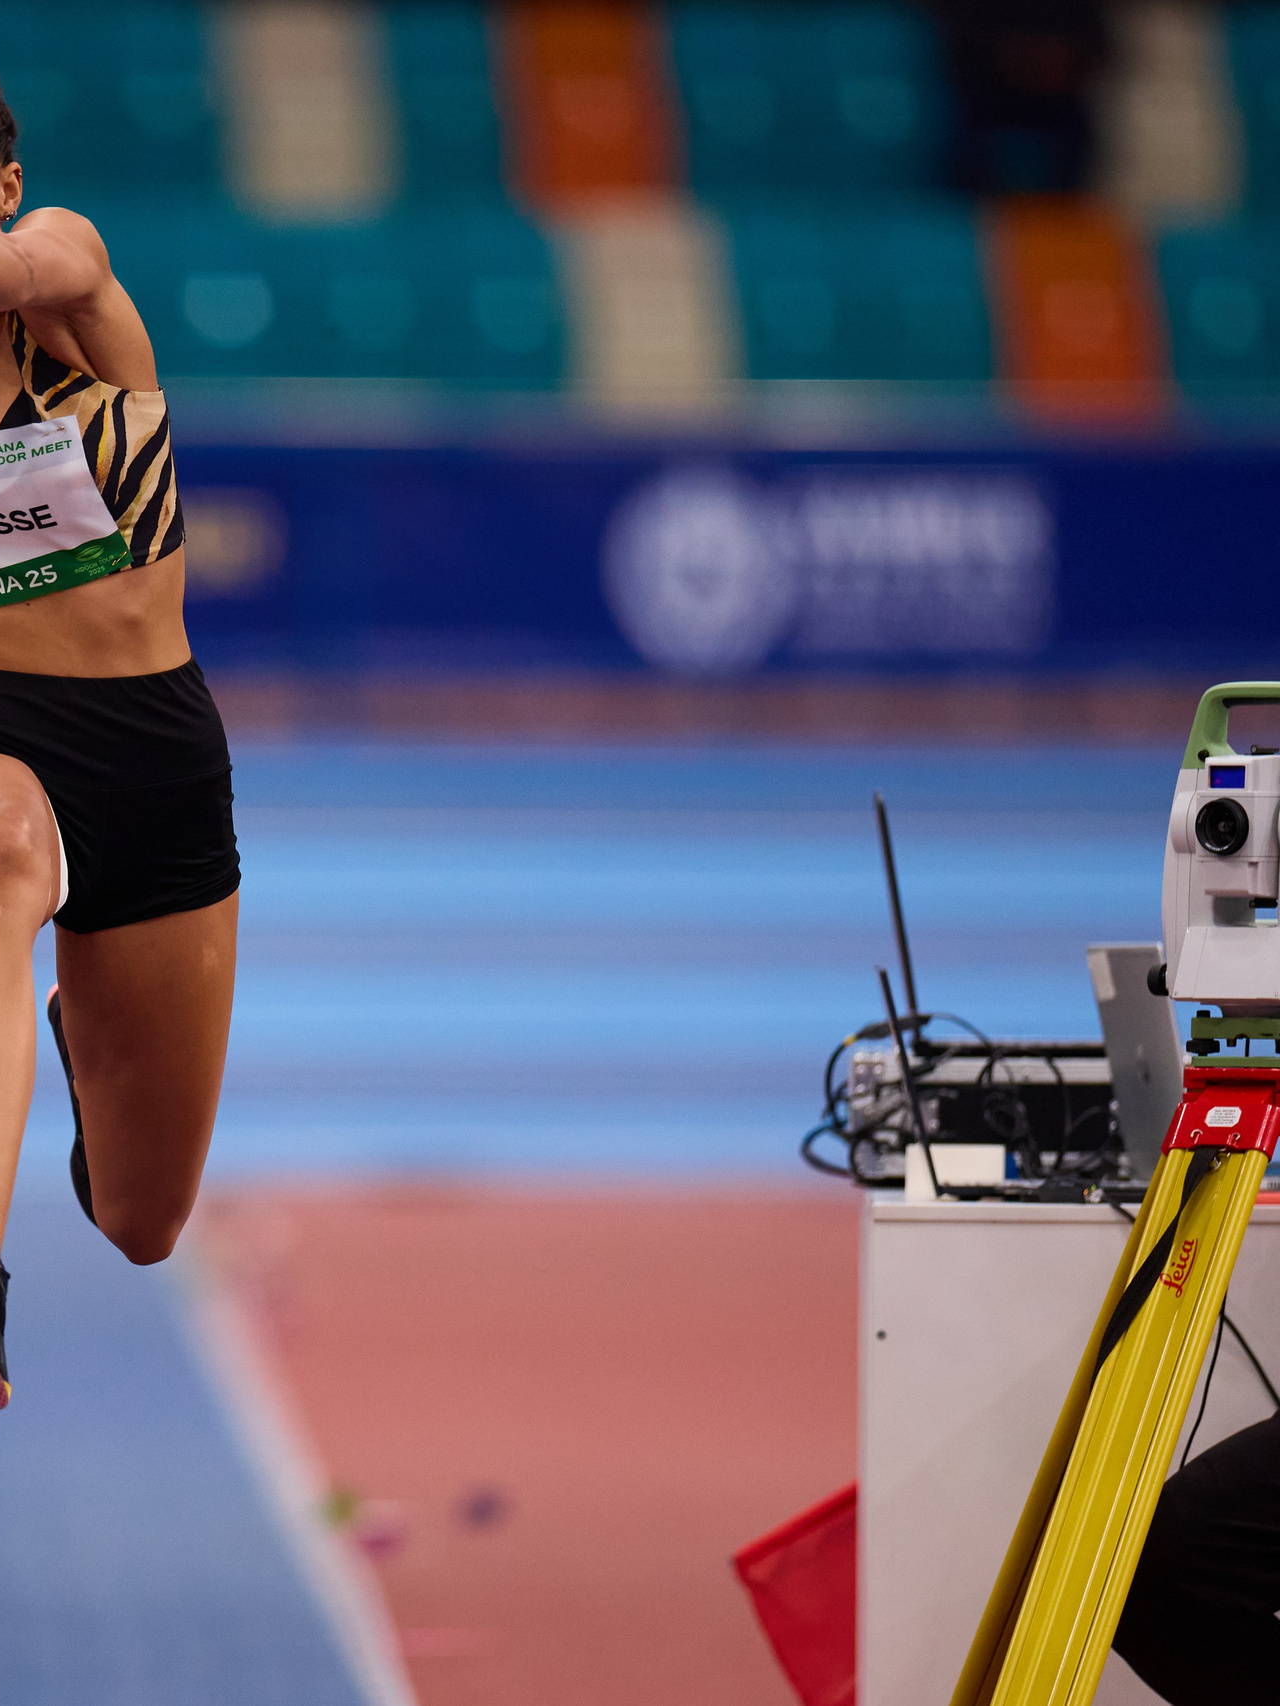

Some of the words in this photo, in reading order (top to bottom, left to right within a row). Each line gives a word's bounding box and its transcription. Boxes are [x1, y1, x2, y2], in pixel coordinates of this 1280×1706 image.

[31, 439, 73, 458] MEET
[24, 564, 58, 588] 25
[1160, 1238, 1198, 1298] Leica
